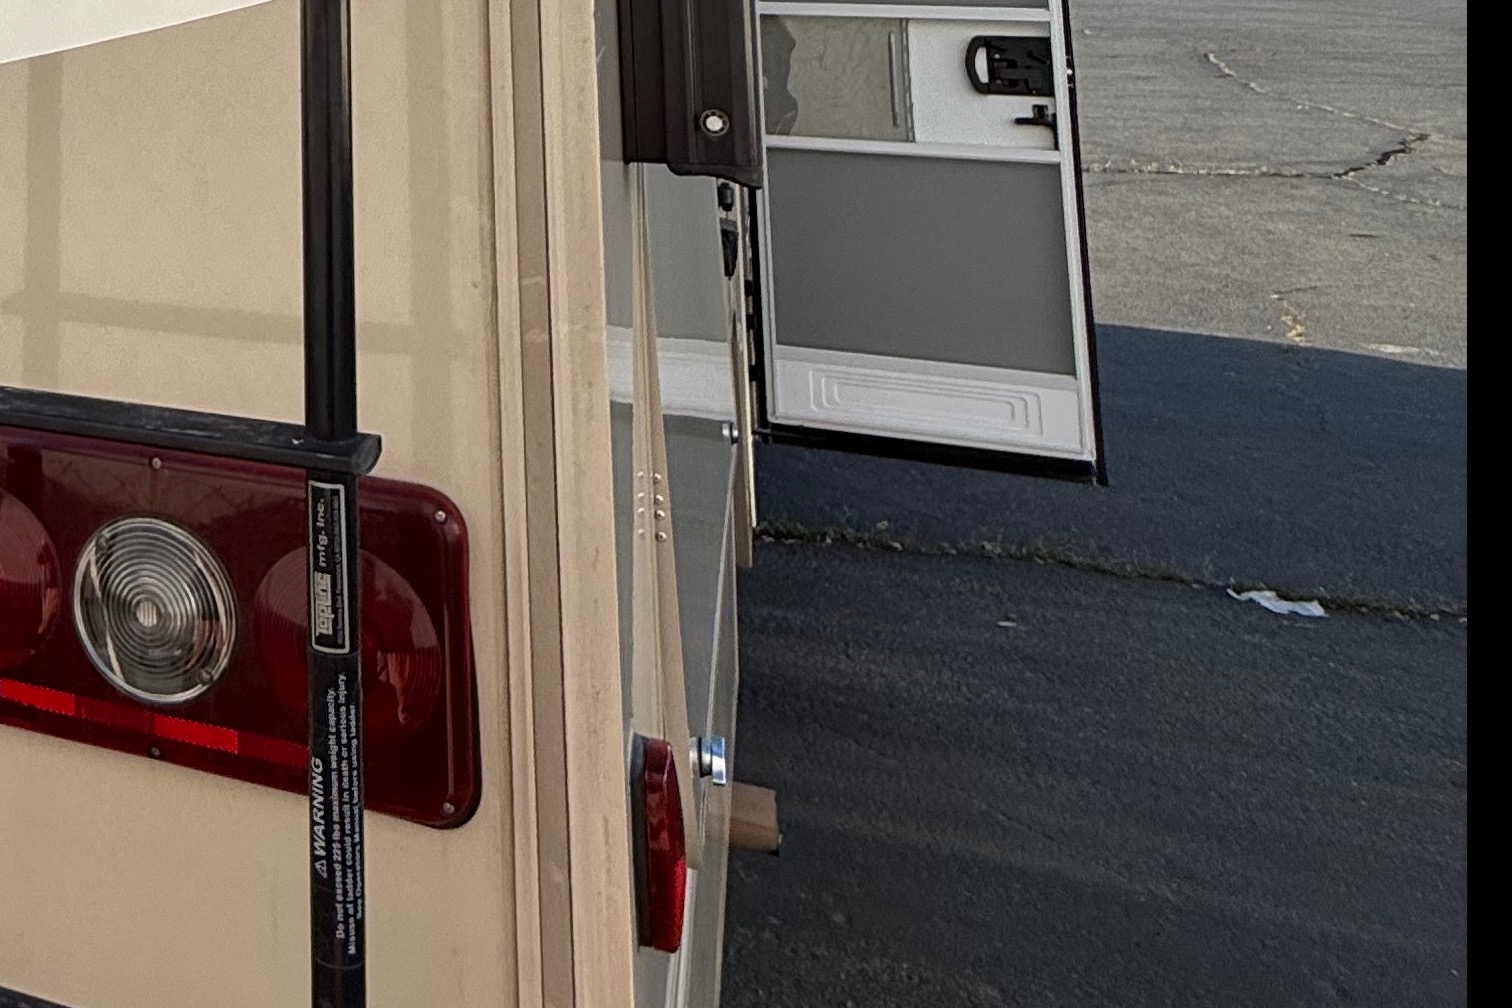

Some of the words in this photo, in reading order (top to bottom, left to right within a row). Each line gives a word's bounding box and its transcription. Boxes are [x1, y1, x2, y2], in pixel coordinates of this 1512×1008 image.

[339, 705, 348, 745] serious
[328, 734, 338, 769] weight
[340, 745, 348, 758] or
[340, 759, 350, 789] death
[311, 756, 326, 856] WARNING
[330, 771, 341, 823] maximum
[341, 791, 350, 803] in
[342, 804, 352, 835] result
[343, 836, 353, 866] could
[333, 863, 344, 902] exceed
[345, 868, 354, 902] ladder
[334, 903, 345, 922] not
[345, 903, 355, 915] of
[335, 923, 346, 939] Do
[346, 917, 357, 955] Misuse
